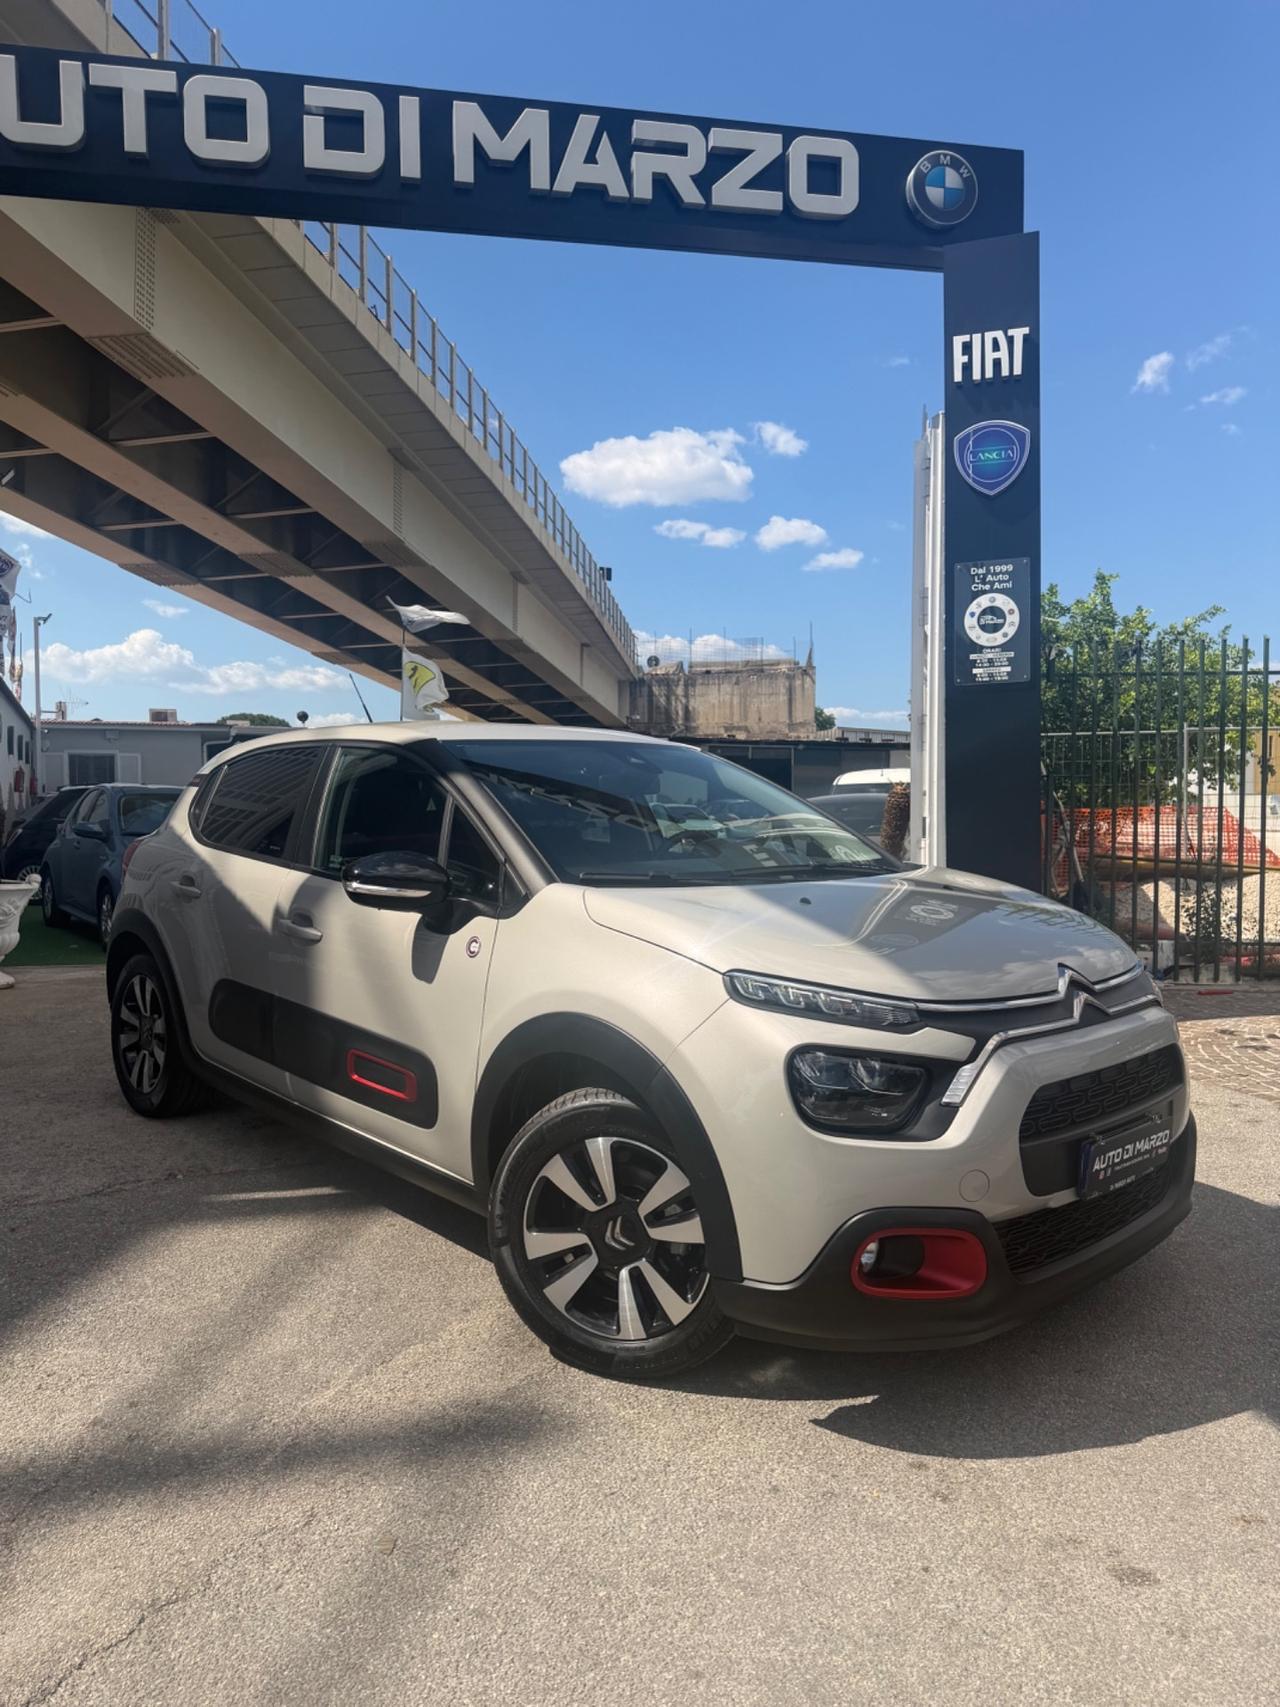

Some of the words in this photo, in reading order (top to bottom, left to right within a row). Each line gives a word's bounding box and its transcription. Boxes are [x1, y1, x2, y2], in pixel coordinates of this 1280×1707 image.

[303, 85, 421, 184] DI
[452, 100, 860, 220] MARZO
[919, 153, 971, 179] BMW
[953, 326, 1030, 383] FIAT
[970, 449, 1014, 463] LANCIA
[970, 565, 987, 575] Dal
[990, 563, 1013, 574] 1999
[985, 573, 1009, 582] Auto
[971, 583, 991, 592] Che
[993, 580, 1012, 590] Ami
[1092, 1147, 1123, 1172] AUTO
[1123, 1142, 1135, 1160] DI
[1134, 1129, 1170, 1156] MARZO
